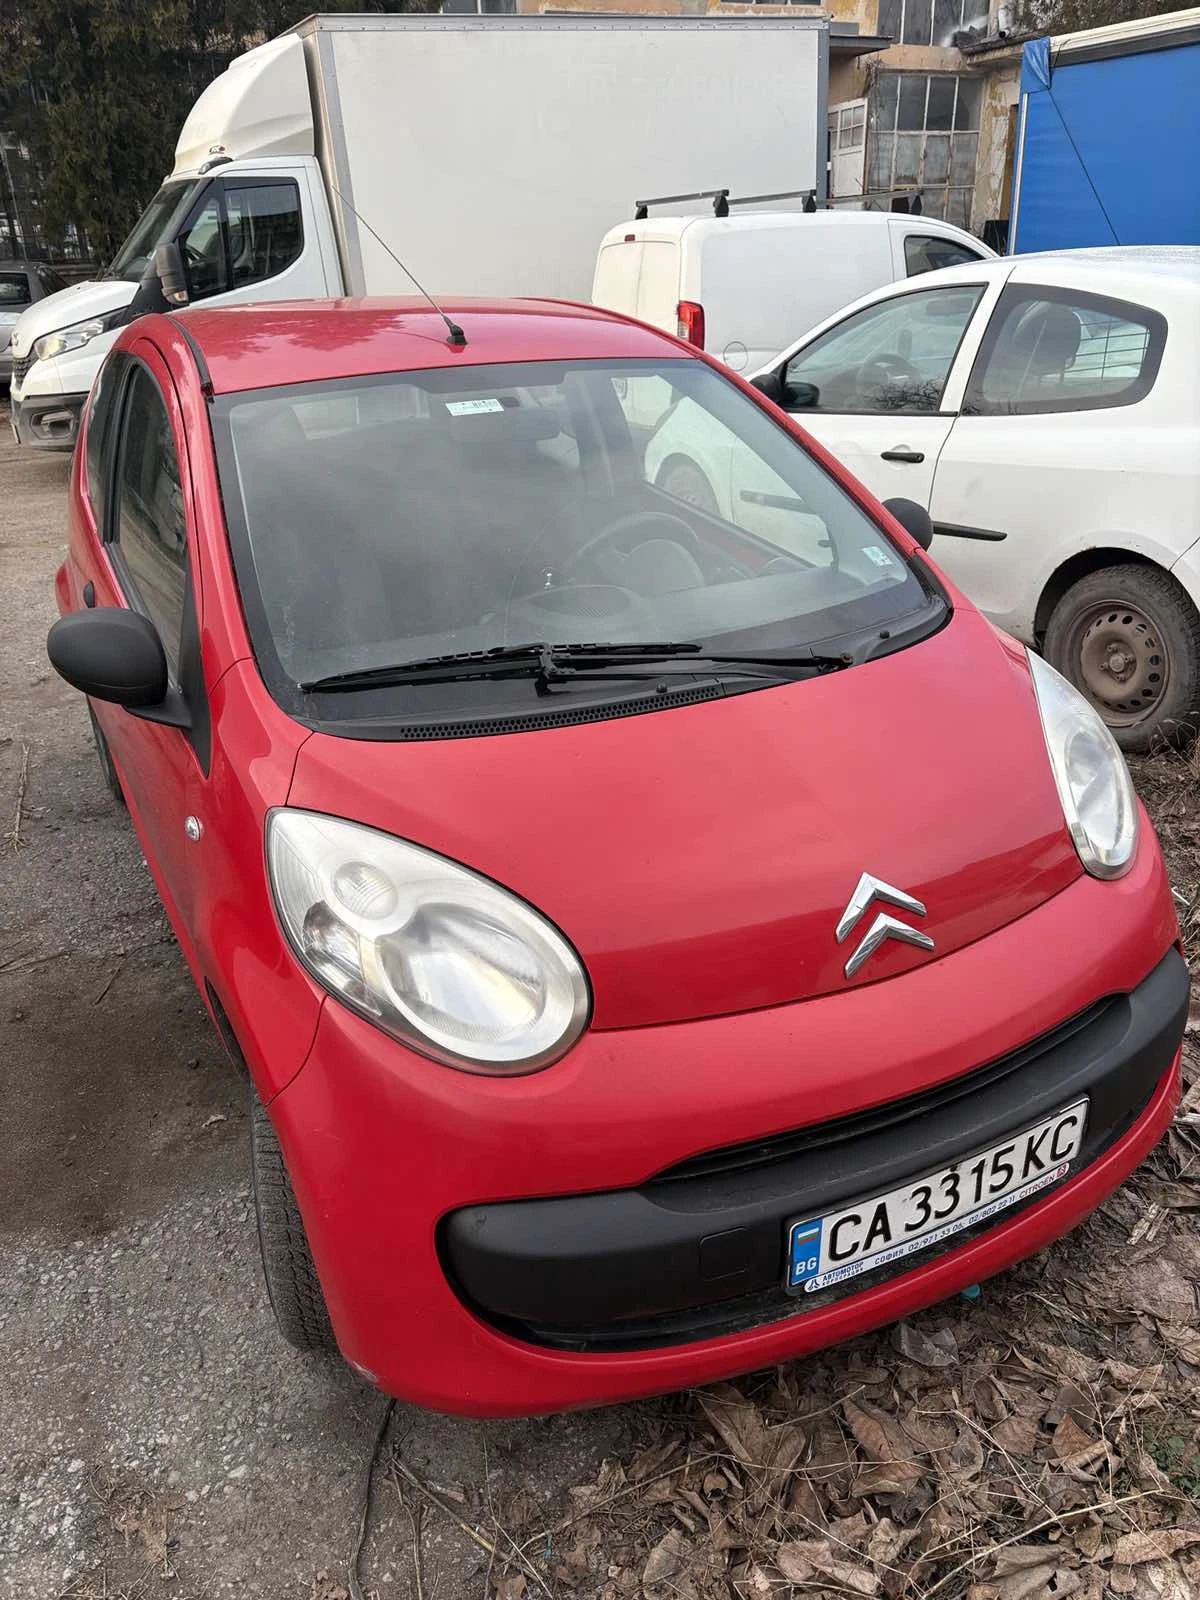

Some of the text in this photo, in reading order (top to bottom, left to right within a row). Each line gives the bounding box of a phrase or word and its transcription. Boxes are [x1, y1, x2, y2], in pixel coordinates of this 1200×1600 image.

[828, 1115, 1078, 1261] CA 3315 KC
[796, 1257, 817, 1276] BG
[874, 1249, 904, 1265] СОФИЯ
[822, 1261, 864, 1282] АВТОМОТОР
